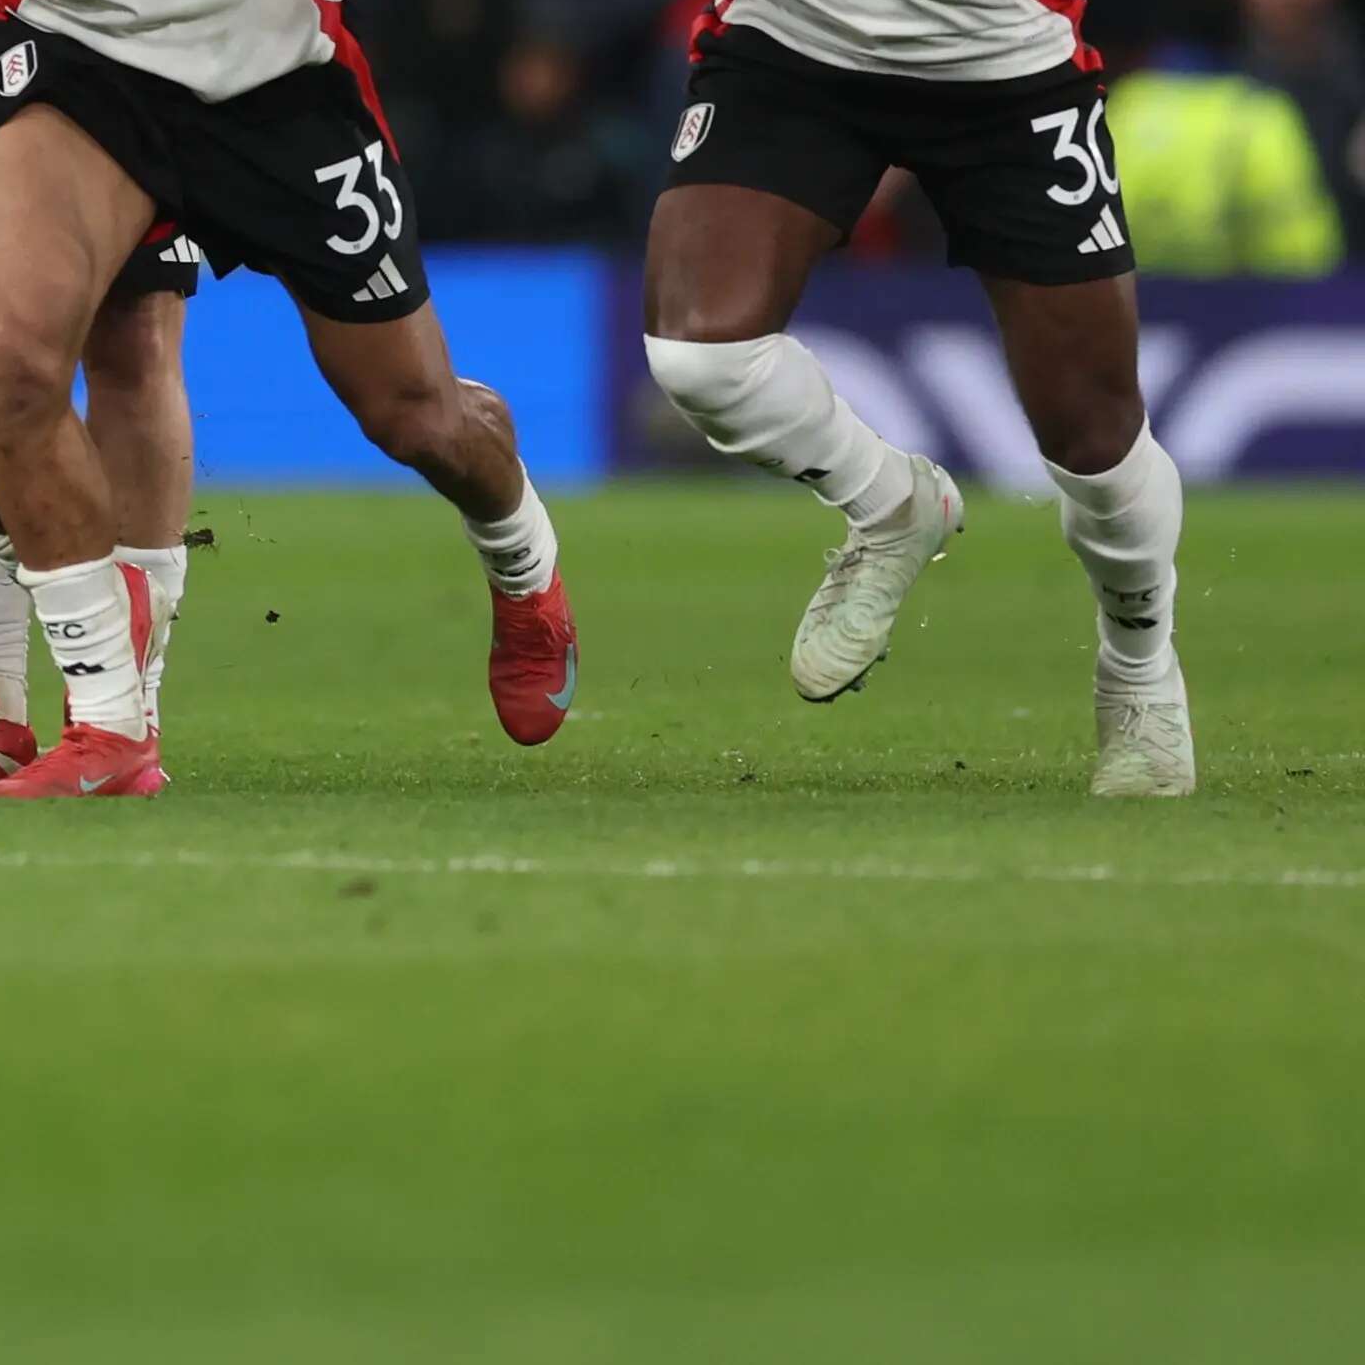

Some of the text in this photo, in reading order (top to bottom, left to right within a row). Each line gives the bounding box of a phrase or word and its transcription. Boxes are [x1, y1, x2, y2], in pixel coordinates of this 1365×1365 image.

[314, 139, 403, 255] 33
[1030, 98, 1119, 205] 30
[46, 622, 86, 639] FC
